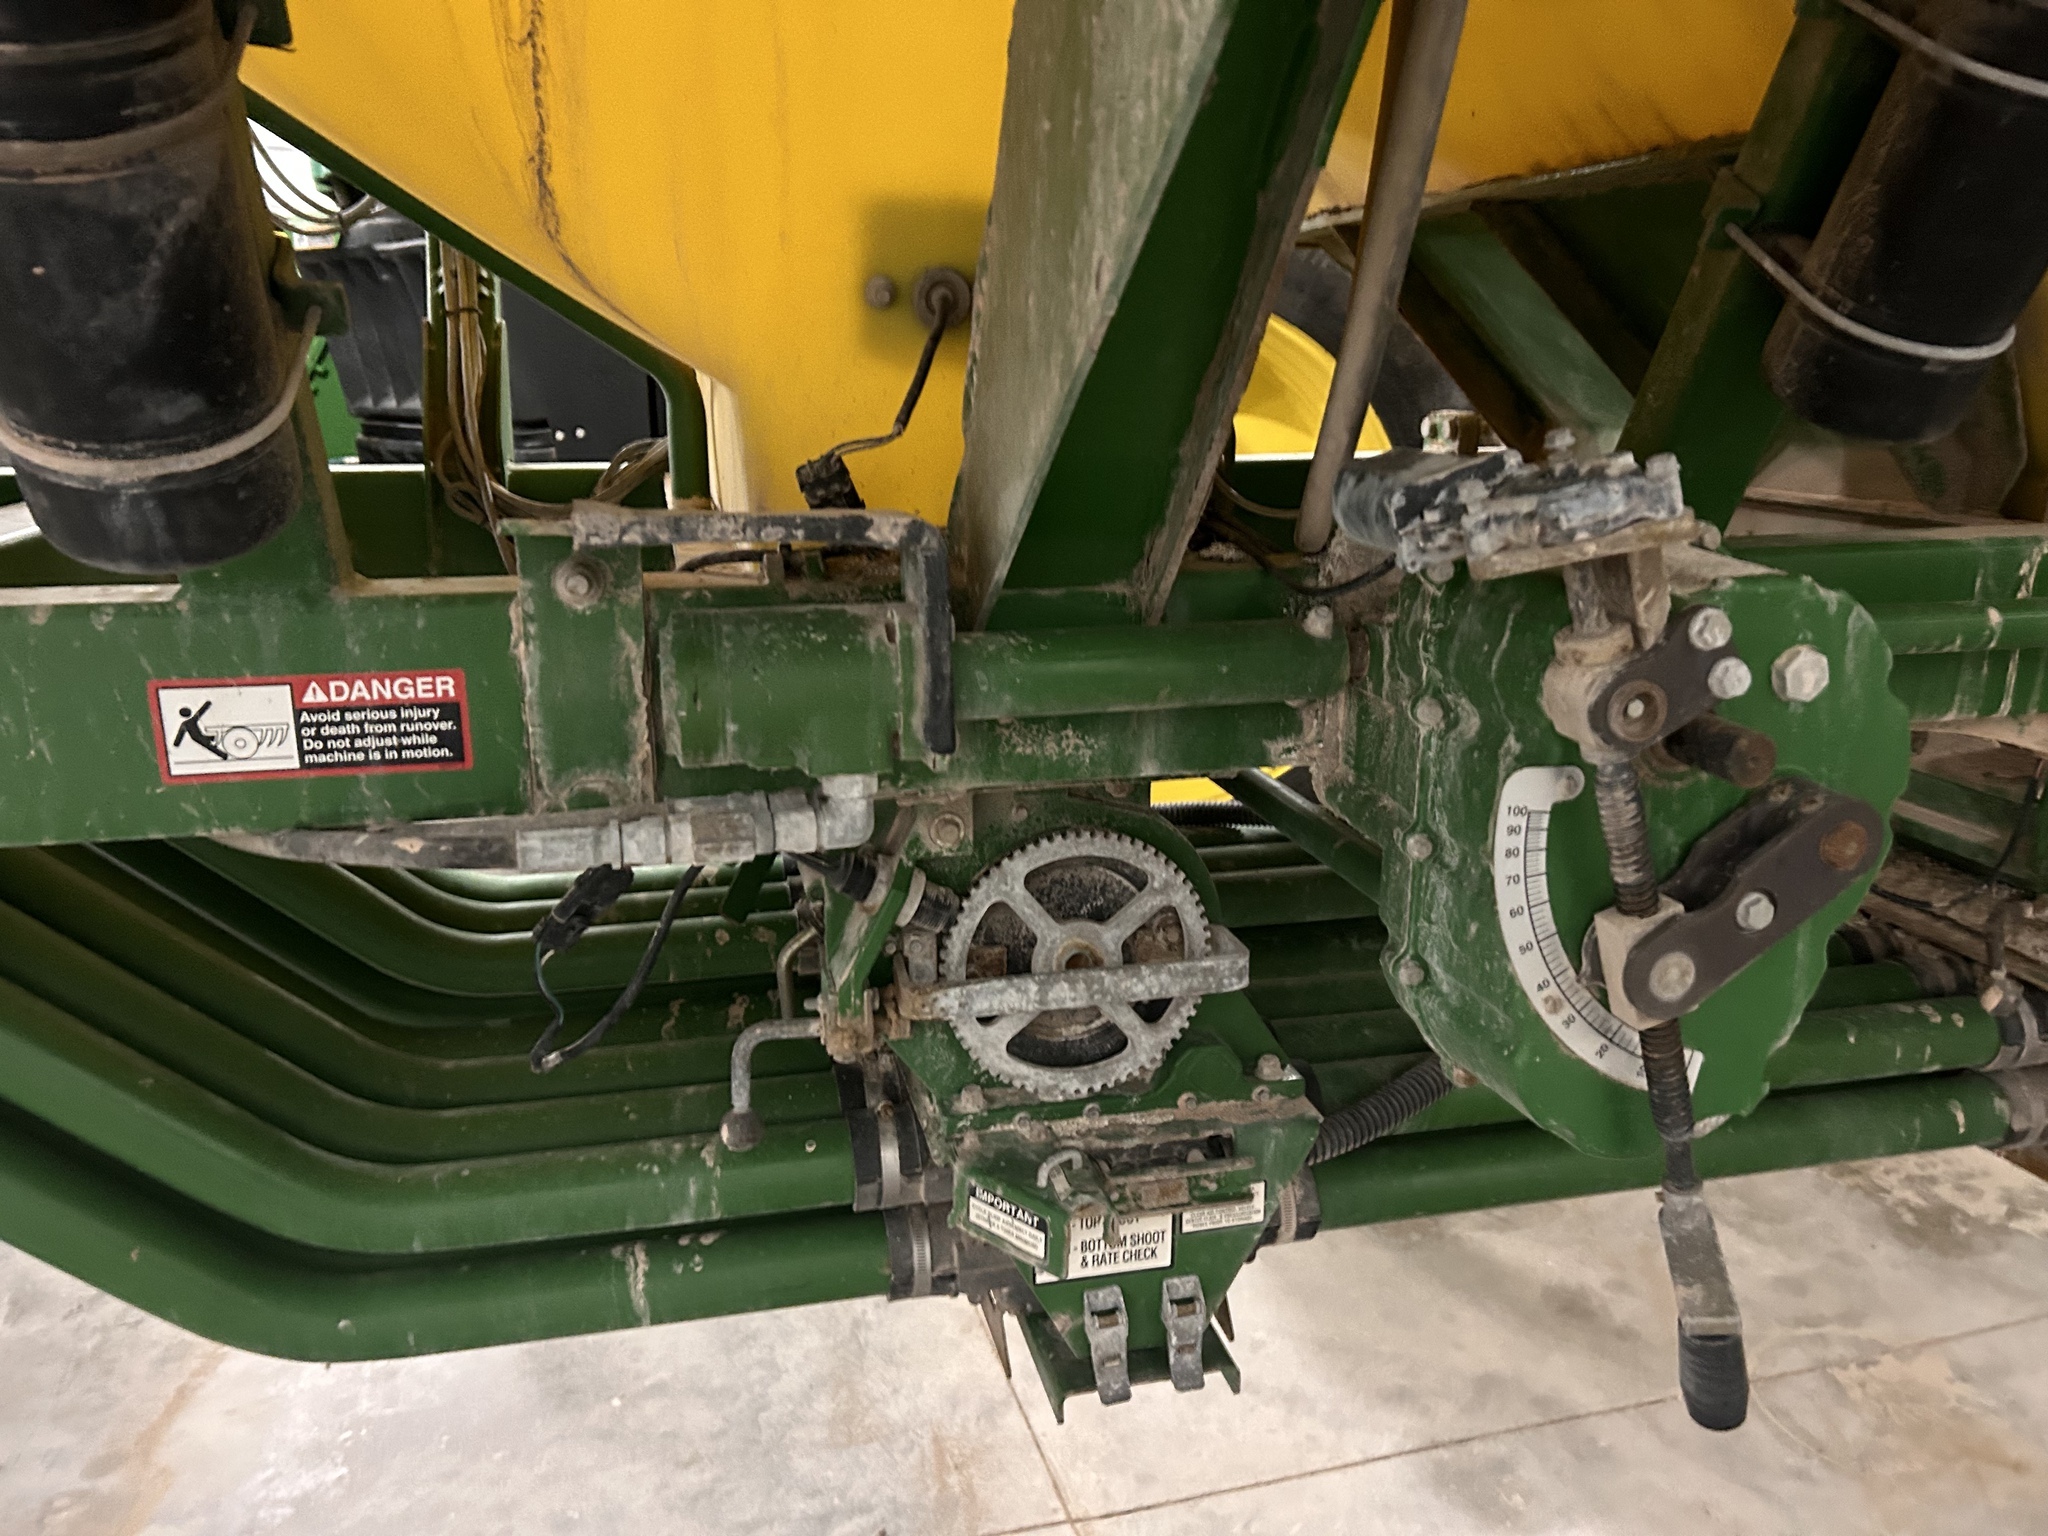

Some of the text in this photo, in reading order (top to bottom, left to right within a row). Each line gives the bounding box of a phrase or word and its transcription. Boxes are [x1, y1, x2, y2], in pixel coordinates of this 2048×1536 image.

[328, 675, 456, 702] DANGER
[300, 705, 440, 723] Avoid serious injury
[301, 719, 457, 737] or death from runover.
[303, 731, 438, 751] Do not adjust while
[304, 744, 454, 764] machine is in motion.
[1507, 805, 1528, 817] 100
[1506, 824, 1522, 837] 90
[1505, 846, 1520, 859] 80
[1505, 873, 1521, 886] 70
[1509, 905, 1524, 919] 60
[1518, 940, 1534, 955] 50
[1536, 977, 1551, 993] 40
[1561, 1013, 1577, 1030] 30
[1594, 1043, 1609, 1060] 20
[975, 1186, 1040, 1229] IMPORTANT
[1080, 1229, 1166, 1254] BOTM SHOOT
[1080, 1245, 1158, 1269] & RATE CHECK
